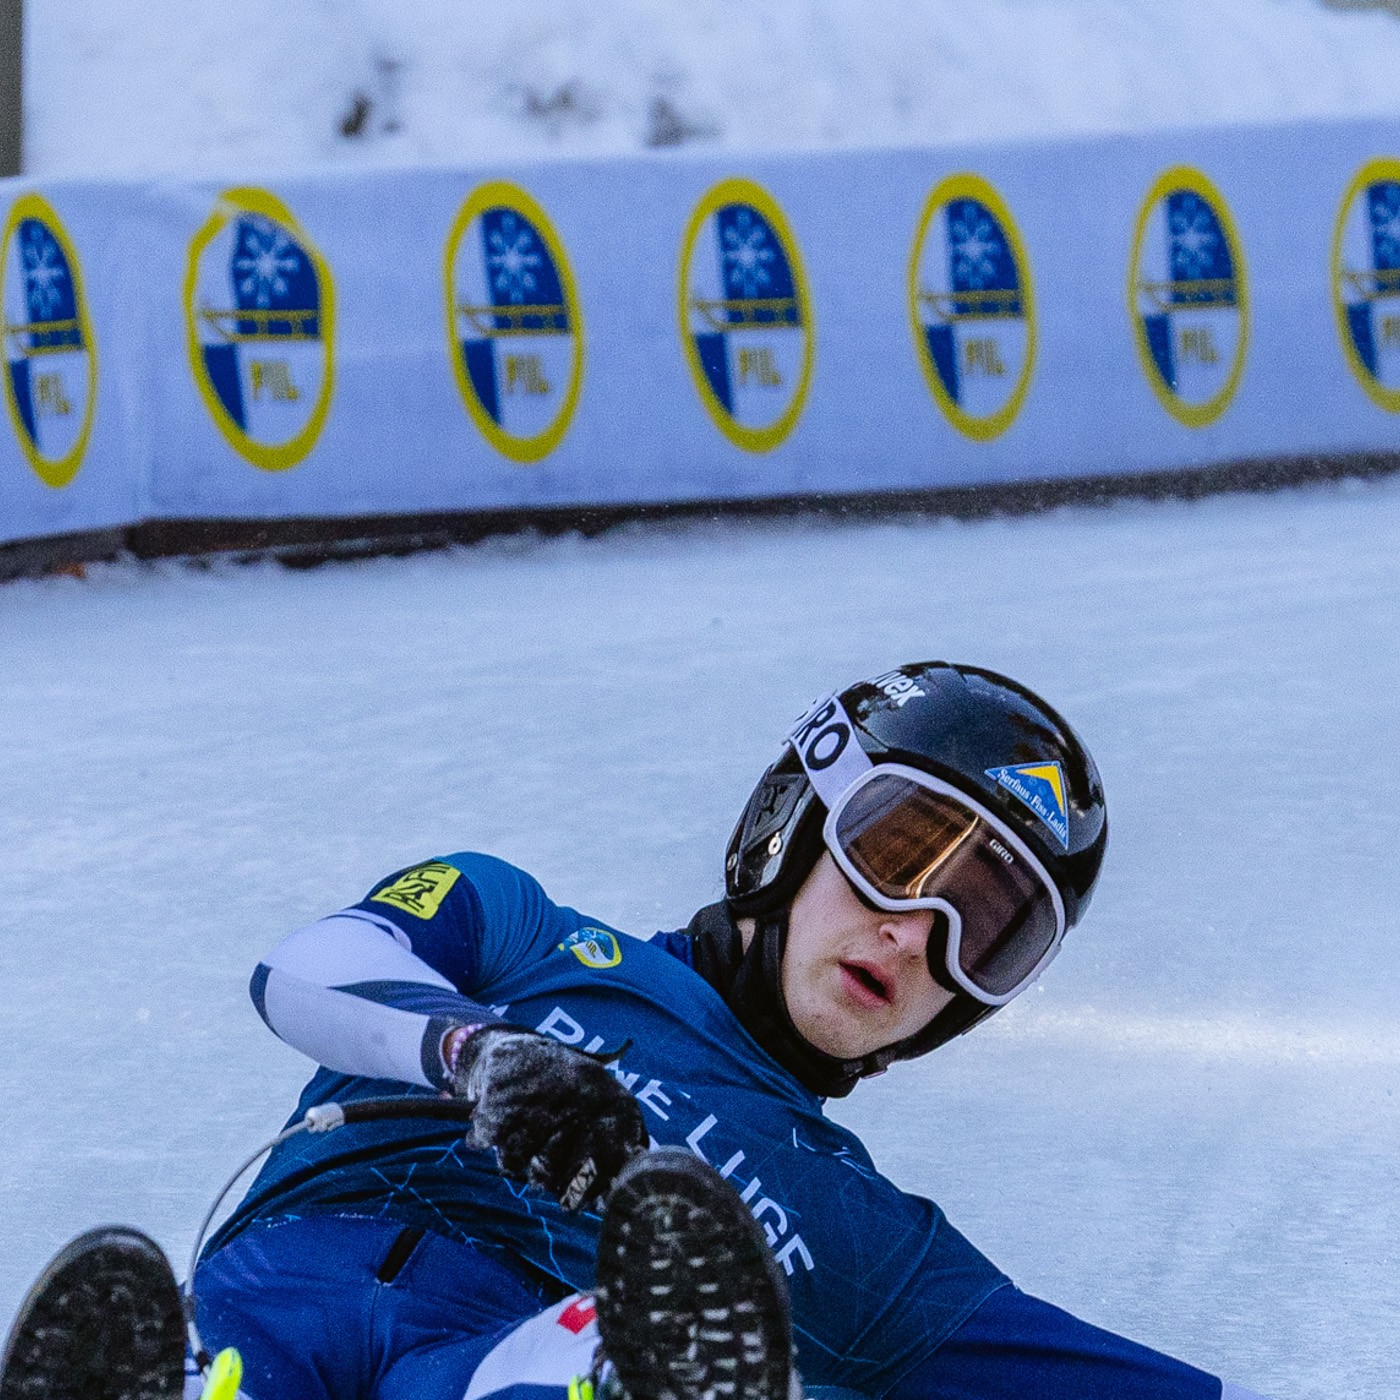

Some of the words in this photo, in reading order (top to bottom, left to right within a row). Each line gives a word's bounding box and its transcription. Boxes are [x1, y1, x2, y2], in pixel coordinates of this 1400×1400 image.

[35, 374, 72, 414] FIL
[249, 360, 300, 401] FIL
[868, 670, 926, 707] vex
[989, 838, 1014, 864] GIRO
